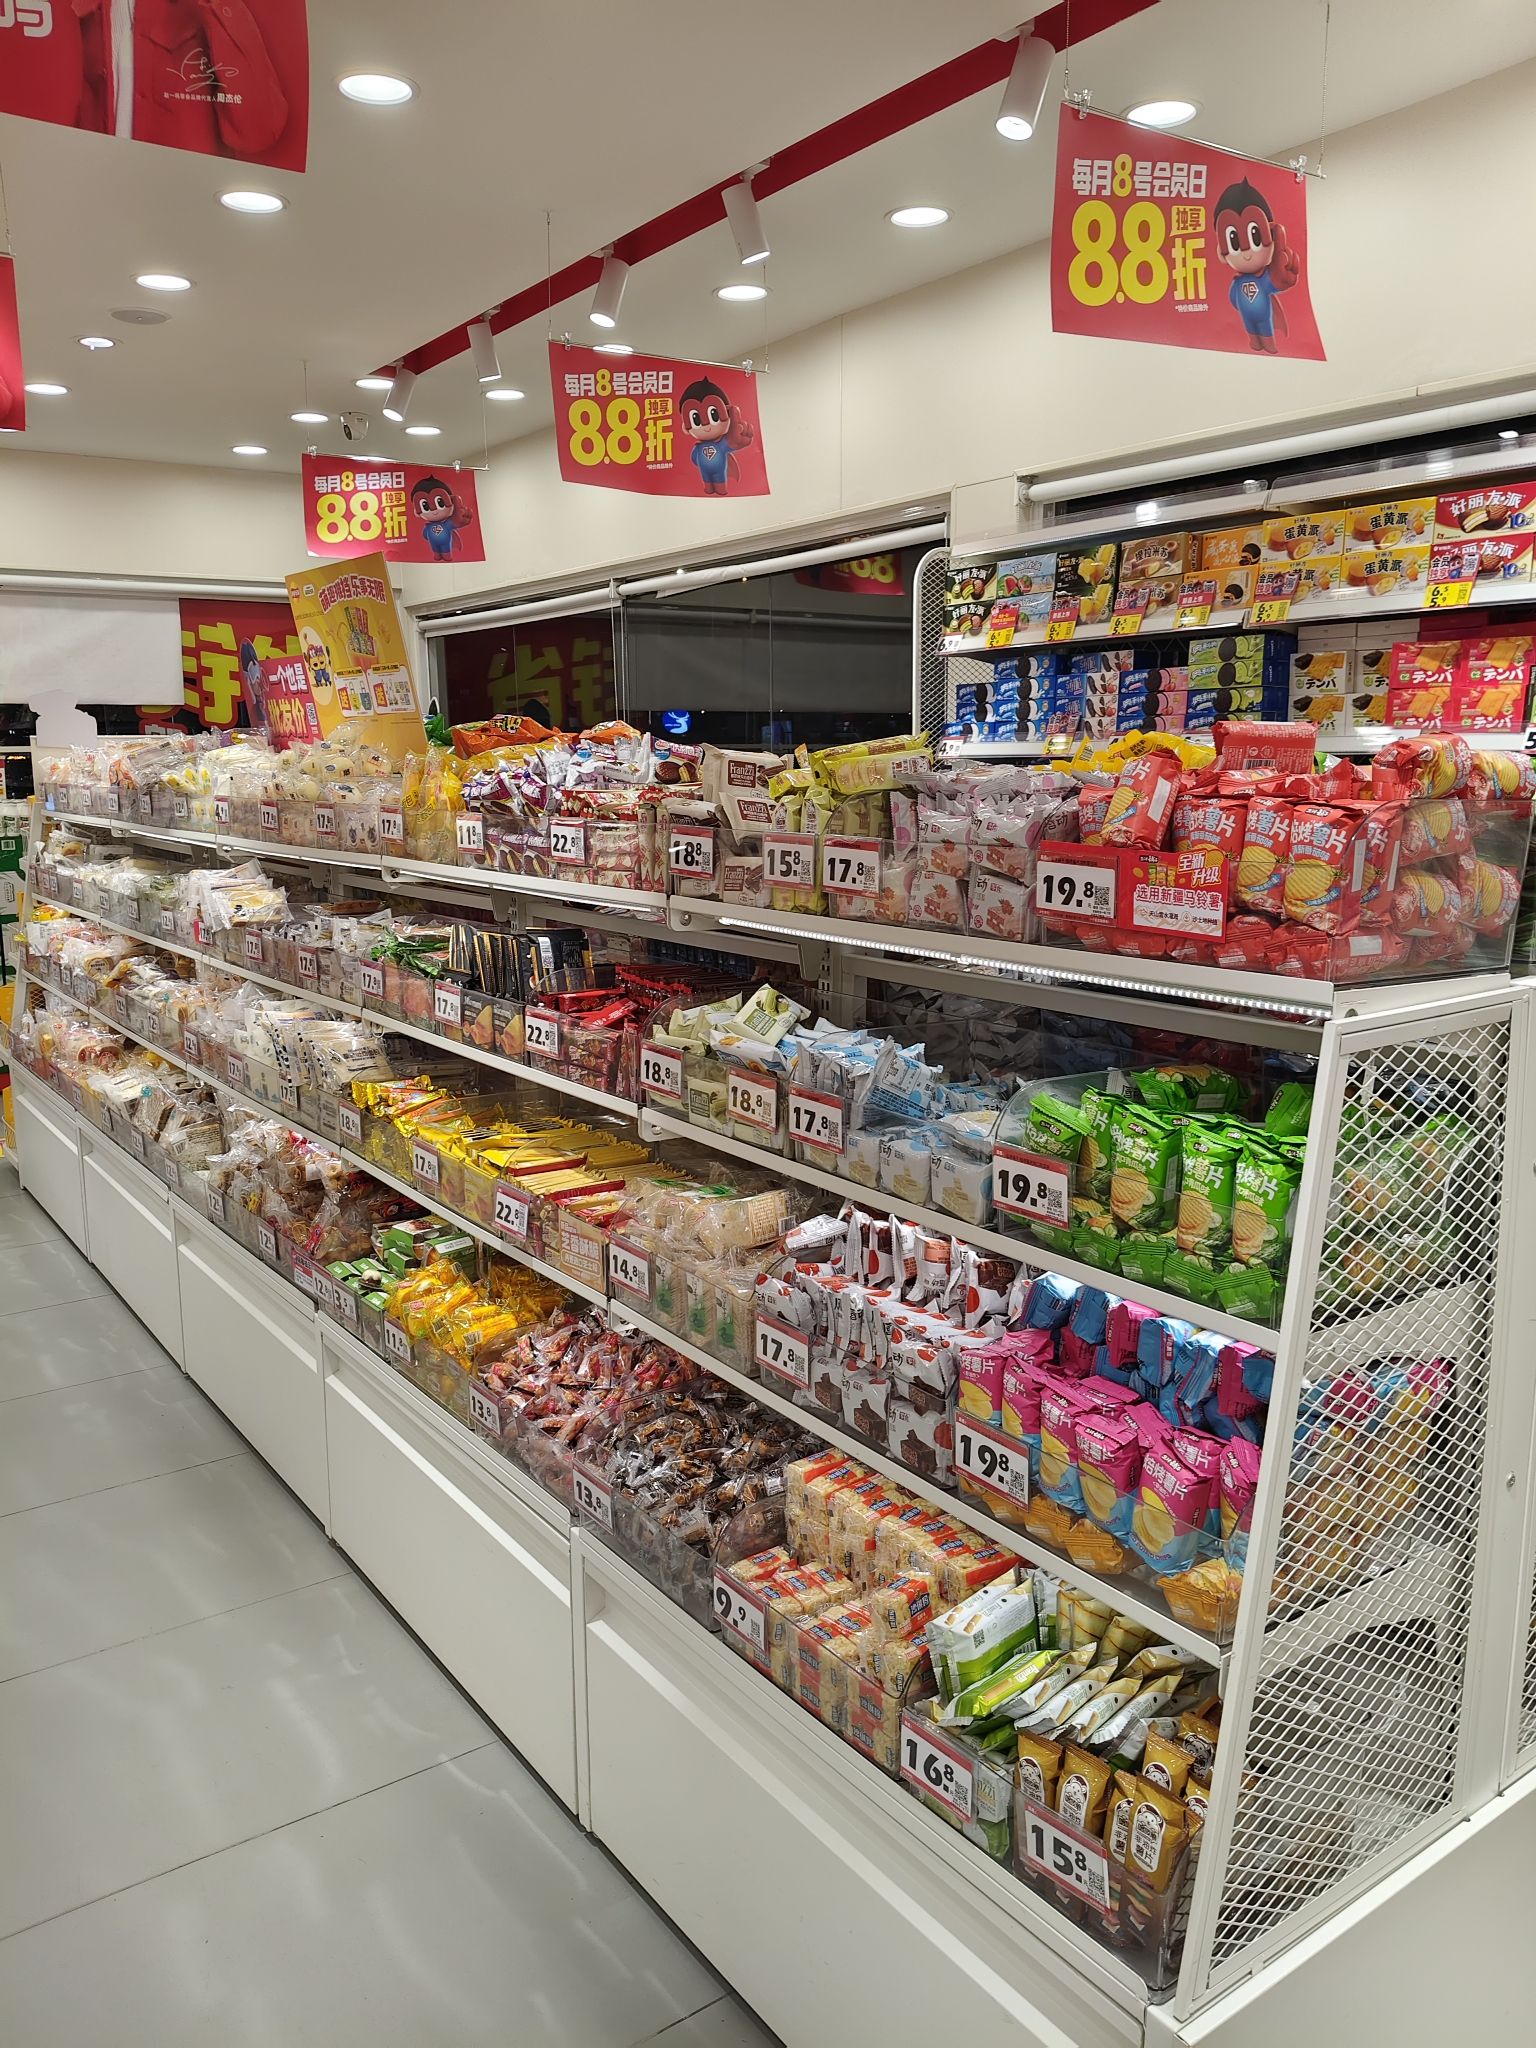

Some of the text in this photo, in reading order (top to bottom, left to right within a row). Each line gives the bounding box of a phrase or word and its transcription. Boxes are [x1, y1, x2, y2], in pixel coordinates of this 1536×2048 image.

[1072, 154, 1207, 199] 每月8号会员日
[1175, 207, 1202, 231] 独享
[564, 368, 673, 397] 每月8号会员日
[314, 471, 405, 493] 每月8号会员日
[1284, 524, 1320, 541] 蛋黄派
[1370, 512, 1408, 530] 蛋黄派
[1364, 559, 1402, 575] 蛋黄派
[1432, 556, 1450, 568] 会员
[1292, 568, 1315, 582] 黄派
[1429, 597, 1447, 608] 5.9
[1431, 586, 1449, 597] 6.5
[268, 663, 308, 692] 一个也是
[1305, 677, 1336, 690] テンバ
[1412, 669, 1455, 683] テンバ
[1483, 666, 1525, 682] テンバ
[267, 698, 307, 735] 批发价
[1473, 715, 1513, 729] テンバ
[939, 742, 954, 755] 4.9
[729, 762, 755, 776] Franzzi
[740, 801, 767, 815] Franzzi
[382, 819, 397, 836] 17.8
[459, 825, 477, 846] 11.8
[552, 833, 576, 854] 22.8
[672, 840, 702, 866] 18.8
[767, 848, 801, 877] 15.8
[827, 857, 865, 885] 17.8
[1178, 852, 1206, 871] 全新
[1192, 867, 1220, 886] 升级
[1043, 874, 1094, 908] 19.8
[1136, 884, 1222, 911] 选用新疆马铃薯
[363, 972, 377, 990] 17.8
[437, 996, 454, 1017] 17.8
[527, 1024, 550, 1047] 22.8
[644, 1058, 671, 1085] 18.8
[731, 1085, 763, 1115] 18.8
[341, 1113, 355, 1132] 18.8
[793, 1106, 828, 1136] 17.8
[415, 1153, 432, 1175] 17.8
[998, 1169, 1048, 1206] 19.8
[496, 1201, 519, 1225] 22.8
[612, 1254, 638, 1283] 14.8
[760, 1333, 795, 1368] 17.8
[471, 1394, 492, 1422] 13.8
[960, 1434, 1010, 1484] 19.8
[1144, 1455, 1187, 1501] 焙烤薯片
[575, 1480, 601, 1512] 13.8
[715, 1586, 747, 1629] 9.9
[906, 1738, 954, 1794] 16.8
[1031, 1824, 1087, 1885] 15.8
